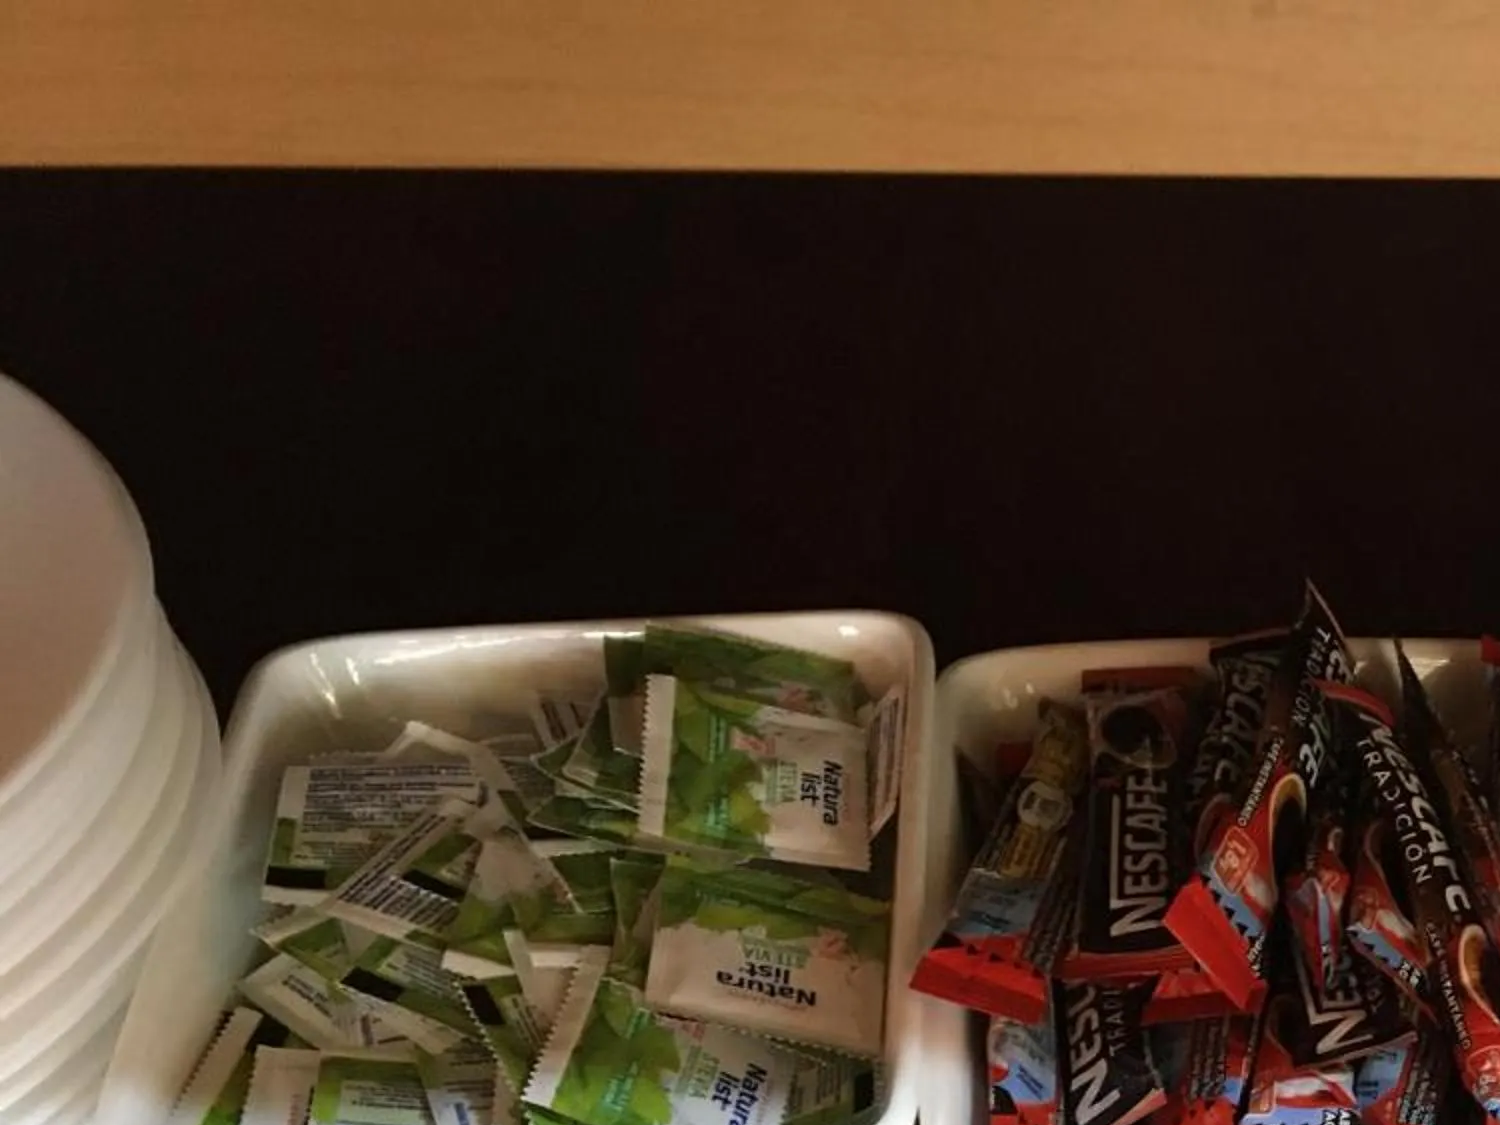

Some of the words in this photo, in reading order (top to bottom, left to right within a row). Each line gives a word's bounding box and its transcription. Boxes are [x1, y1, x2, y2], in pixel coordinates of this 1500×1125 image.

[800, 771, 822, 807] list
[823, 759, 844, 827] Natura
[716, 970, 817, 1007] Natura
[746, 961, 791, 986] list
[711, 1071, 742, 1111] list
